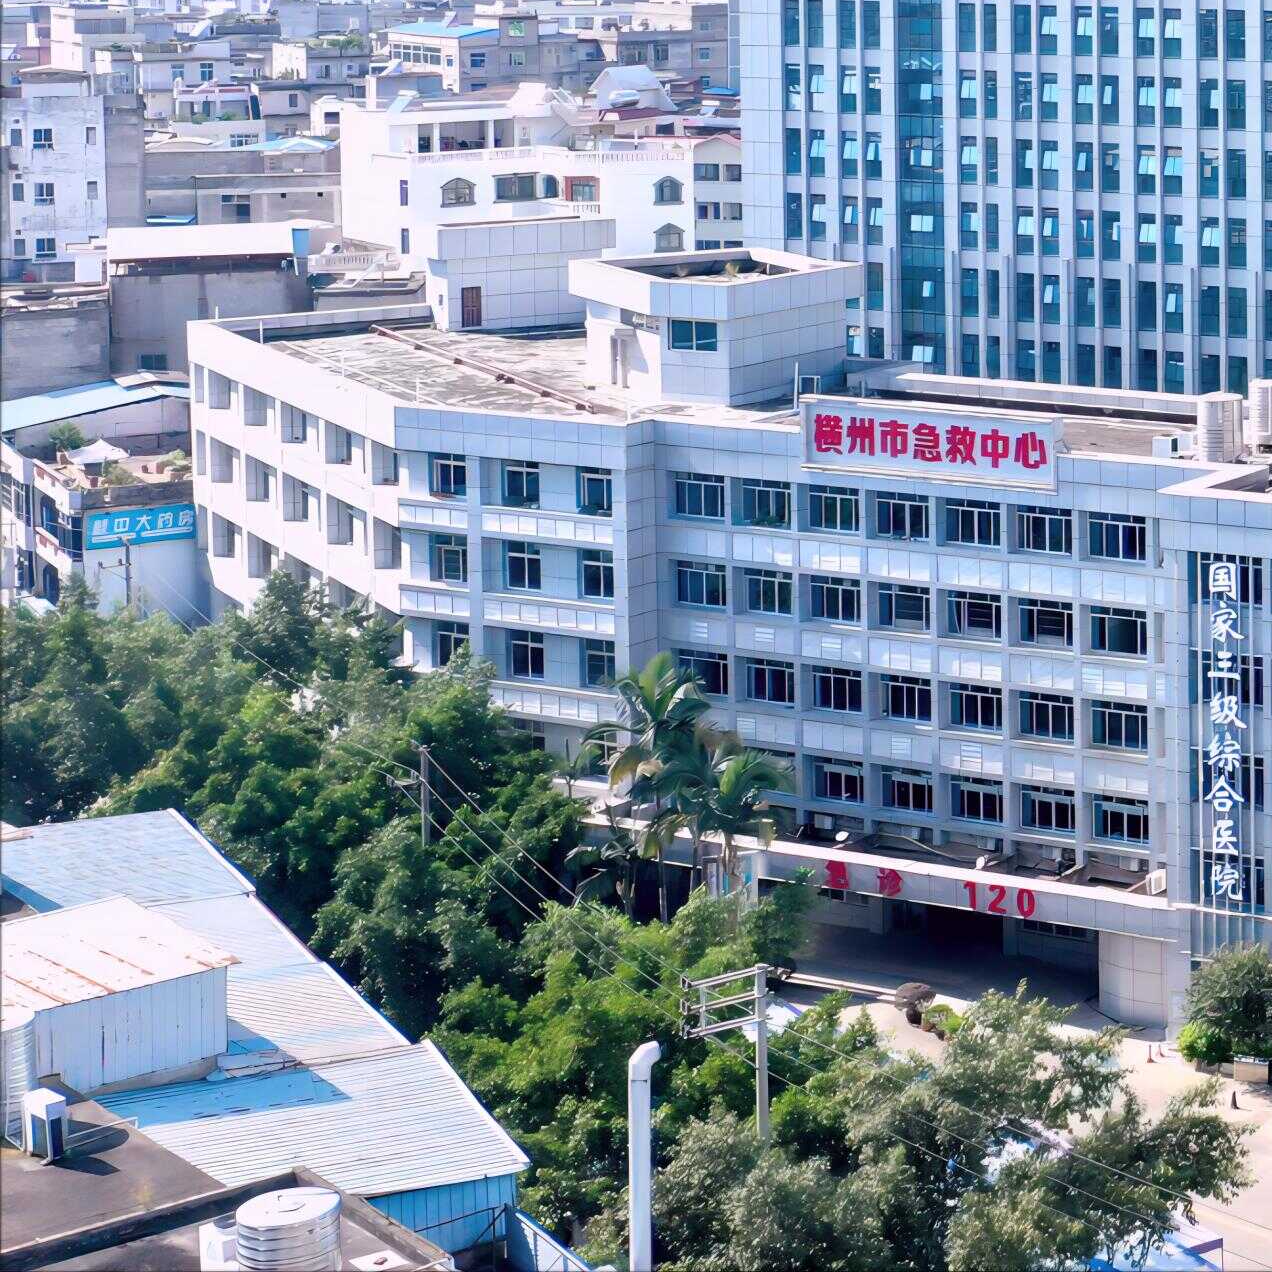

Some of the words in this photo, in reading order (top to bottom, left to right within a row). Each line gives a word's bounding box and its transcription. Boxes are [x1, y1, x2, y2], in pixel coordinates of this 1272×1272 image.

[814, 414, 1048, 469] 横州市急救中心
[1204, 562, 1247, 901] 国家三级综合医院
[963, 880, 1036, 918] 120
